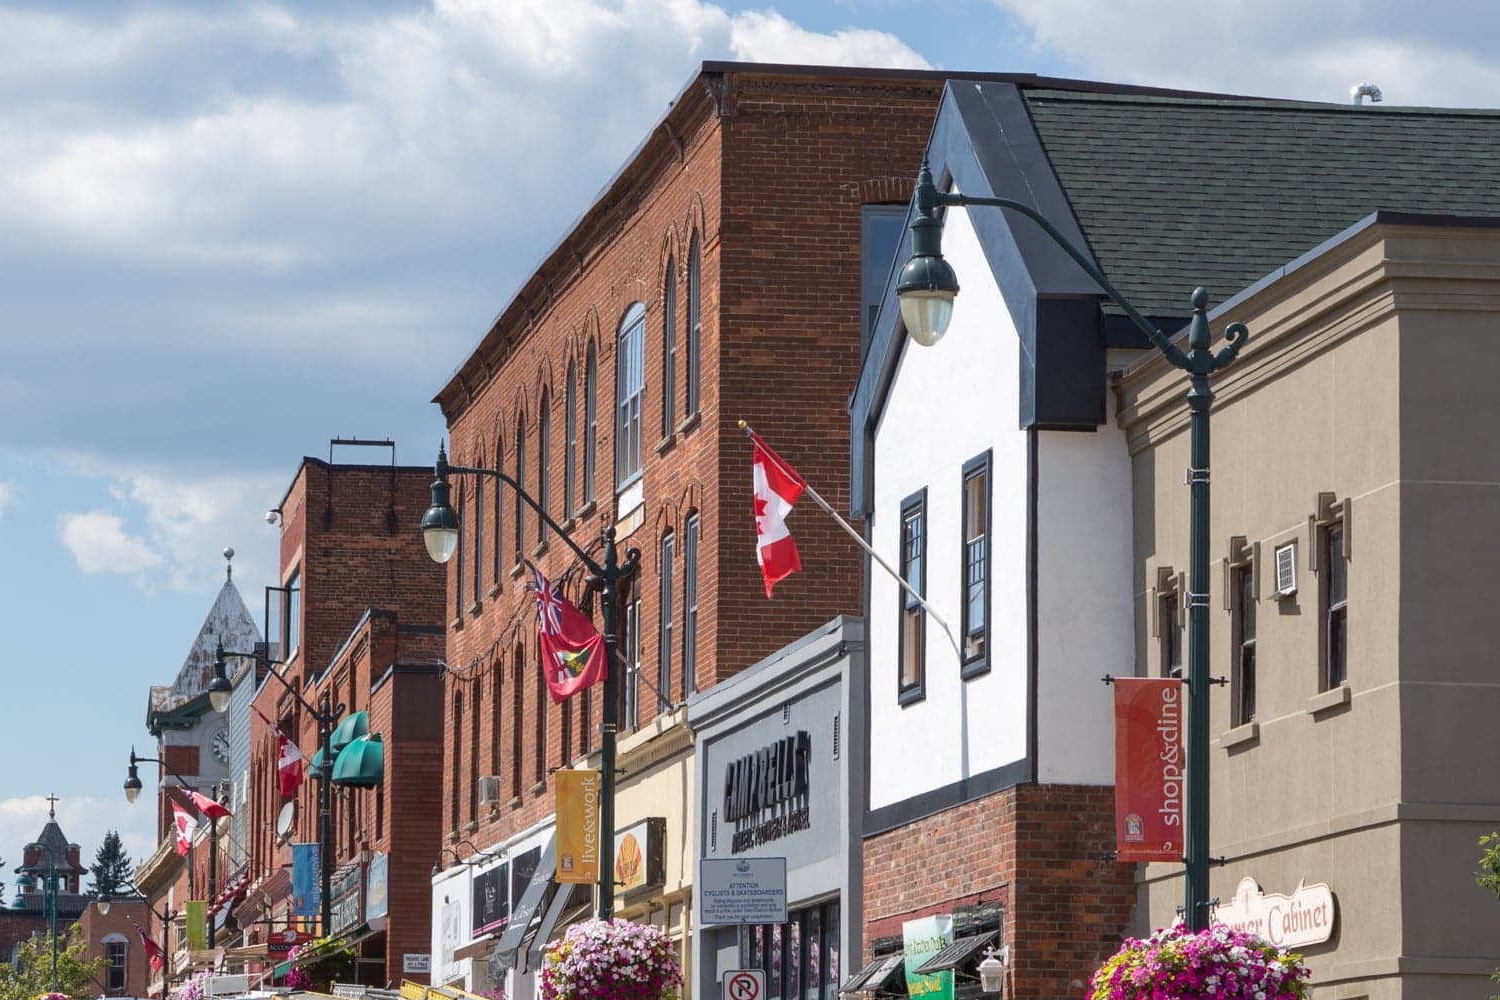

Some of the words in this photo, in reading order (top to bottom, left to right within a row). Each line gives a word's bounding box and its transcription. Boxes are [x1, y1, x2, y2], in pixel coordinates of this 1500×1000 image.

[1157, 687, 1184, 827] shop&dine
[581, 774, 595, 865] live&work
[703, 889, 730, 897] CYCLISTS
[736, 888, 783, 897] SKATEBOARDERS
[1268, 901, 1328, 945] Cabinet
